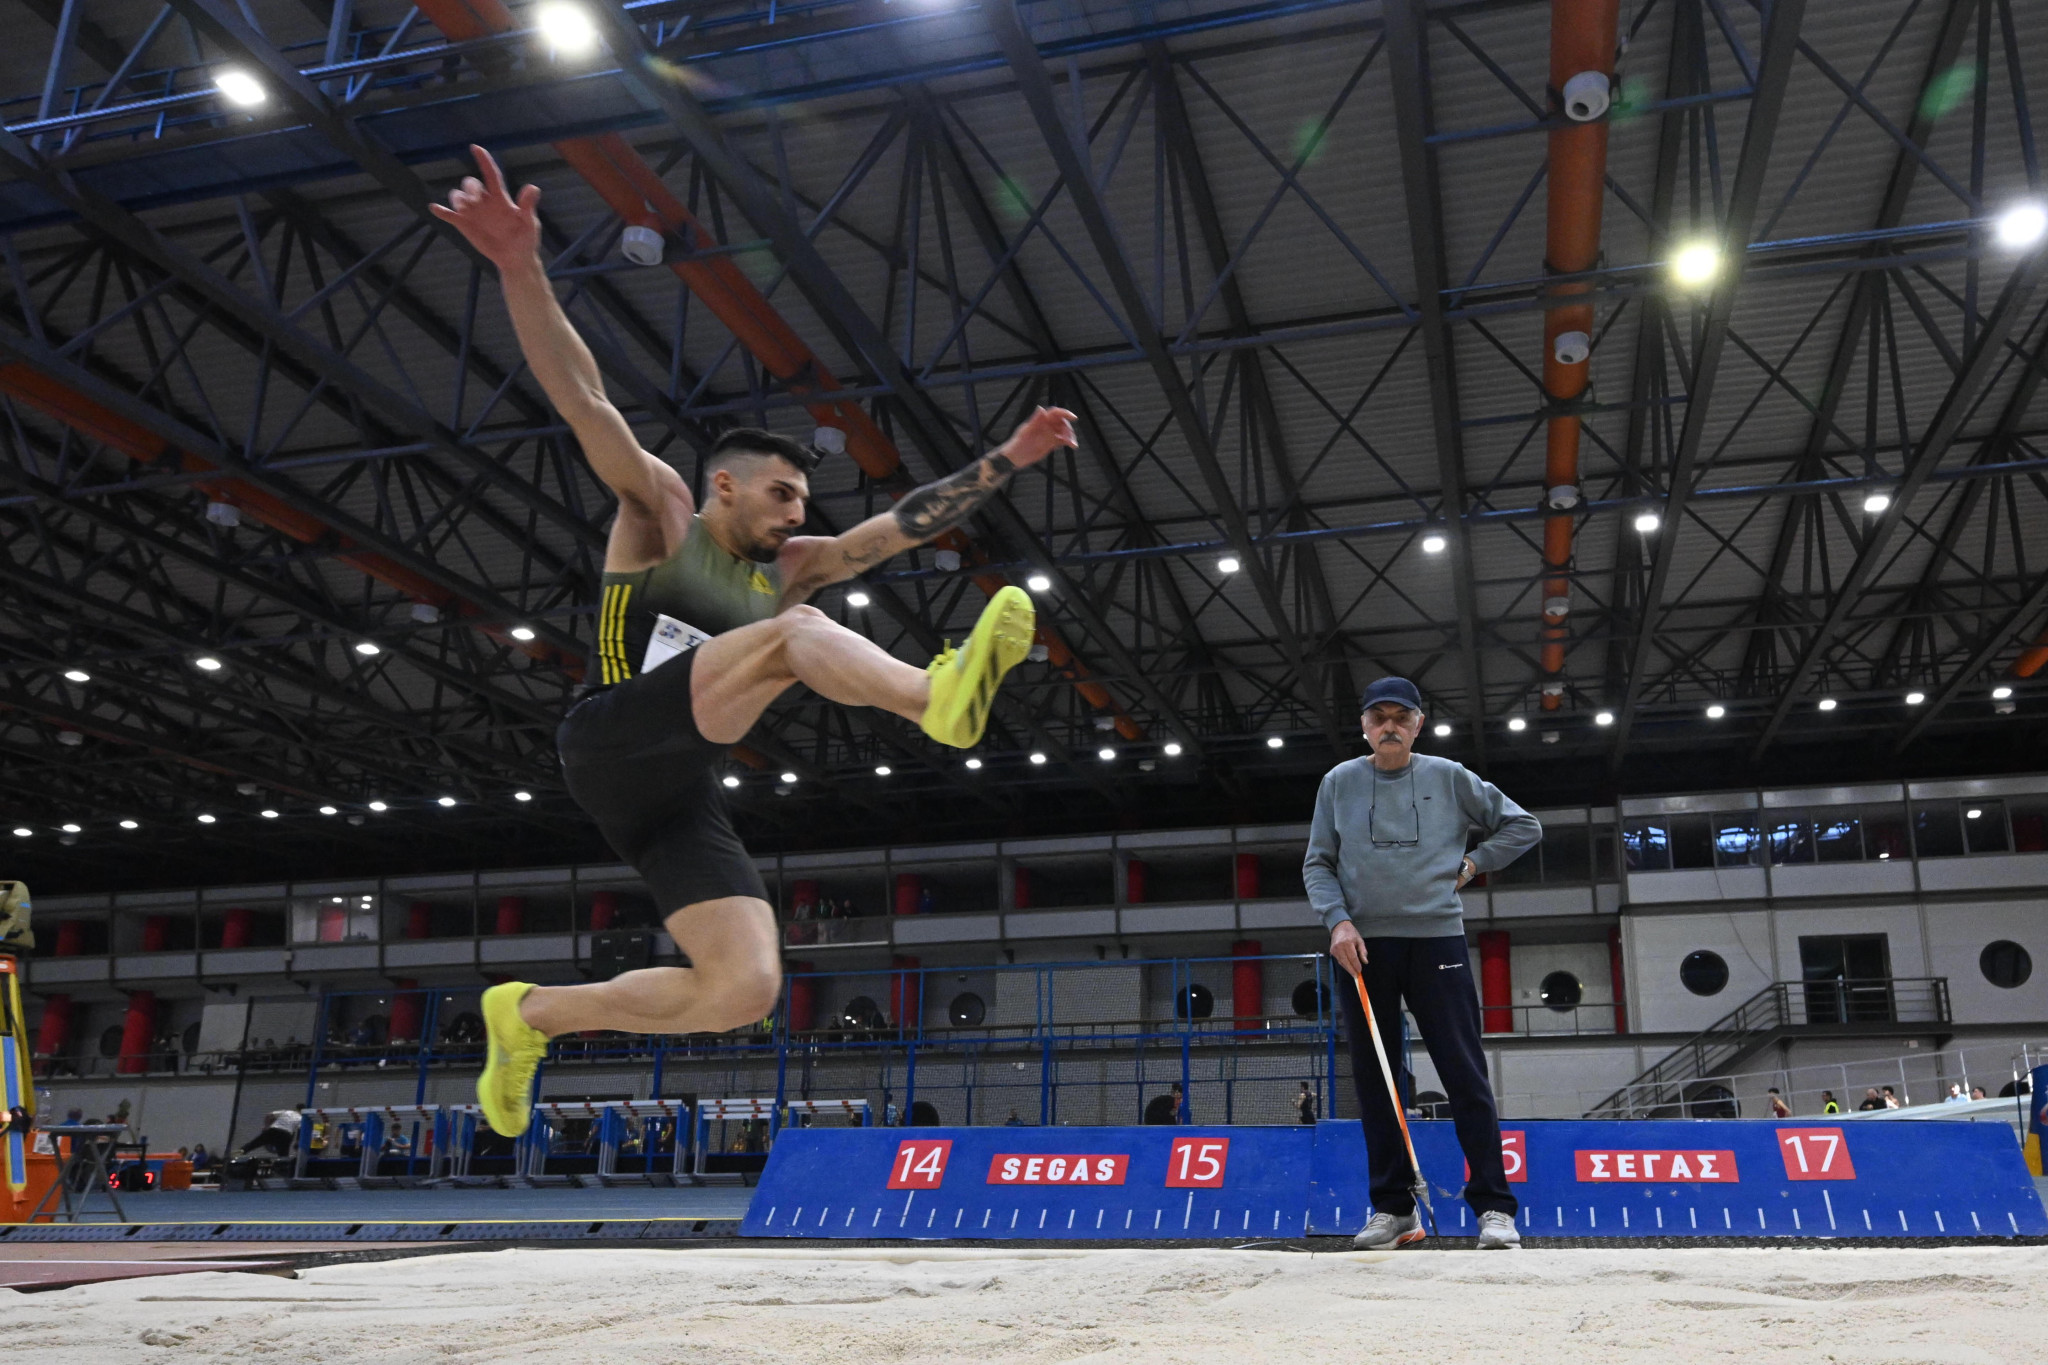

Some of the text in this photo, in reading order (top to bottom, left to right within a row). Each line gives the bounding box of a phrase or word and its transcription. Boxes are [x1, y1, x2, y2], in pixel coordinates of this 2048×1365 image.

[899, 1146, 943, 1182] 14
[1000, 1157, 1116, 1182] SEGAS
[1177, 1144, 1223, 1181] 15
[1589, 1153, 1720, 1179] ΣΕΓΑΣ
[1784, 1134, 1840, 1173] 17
